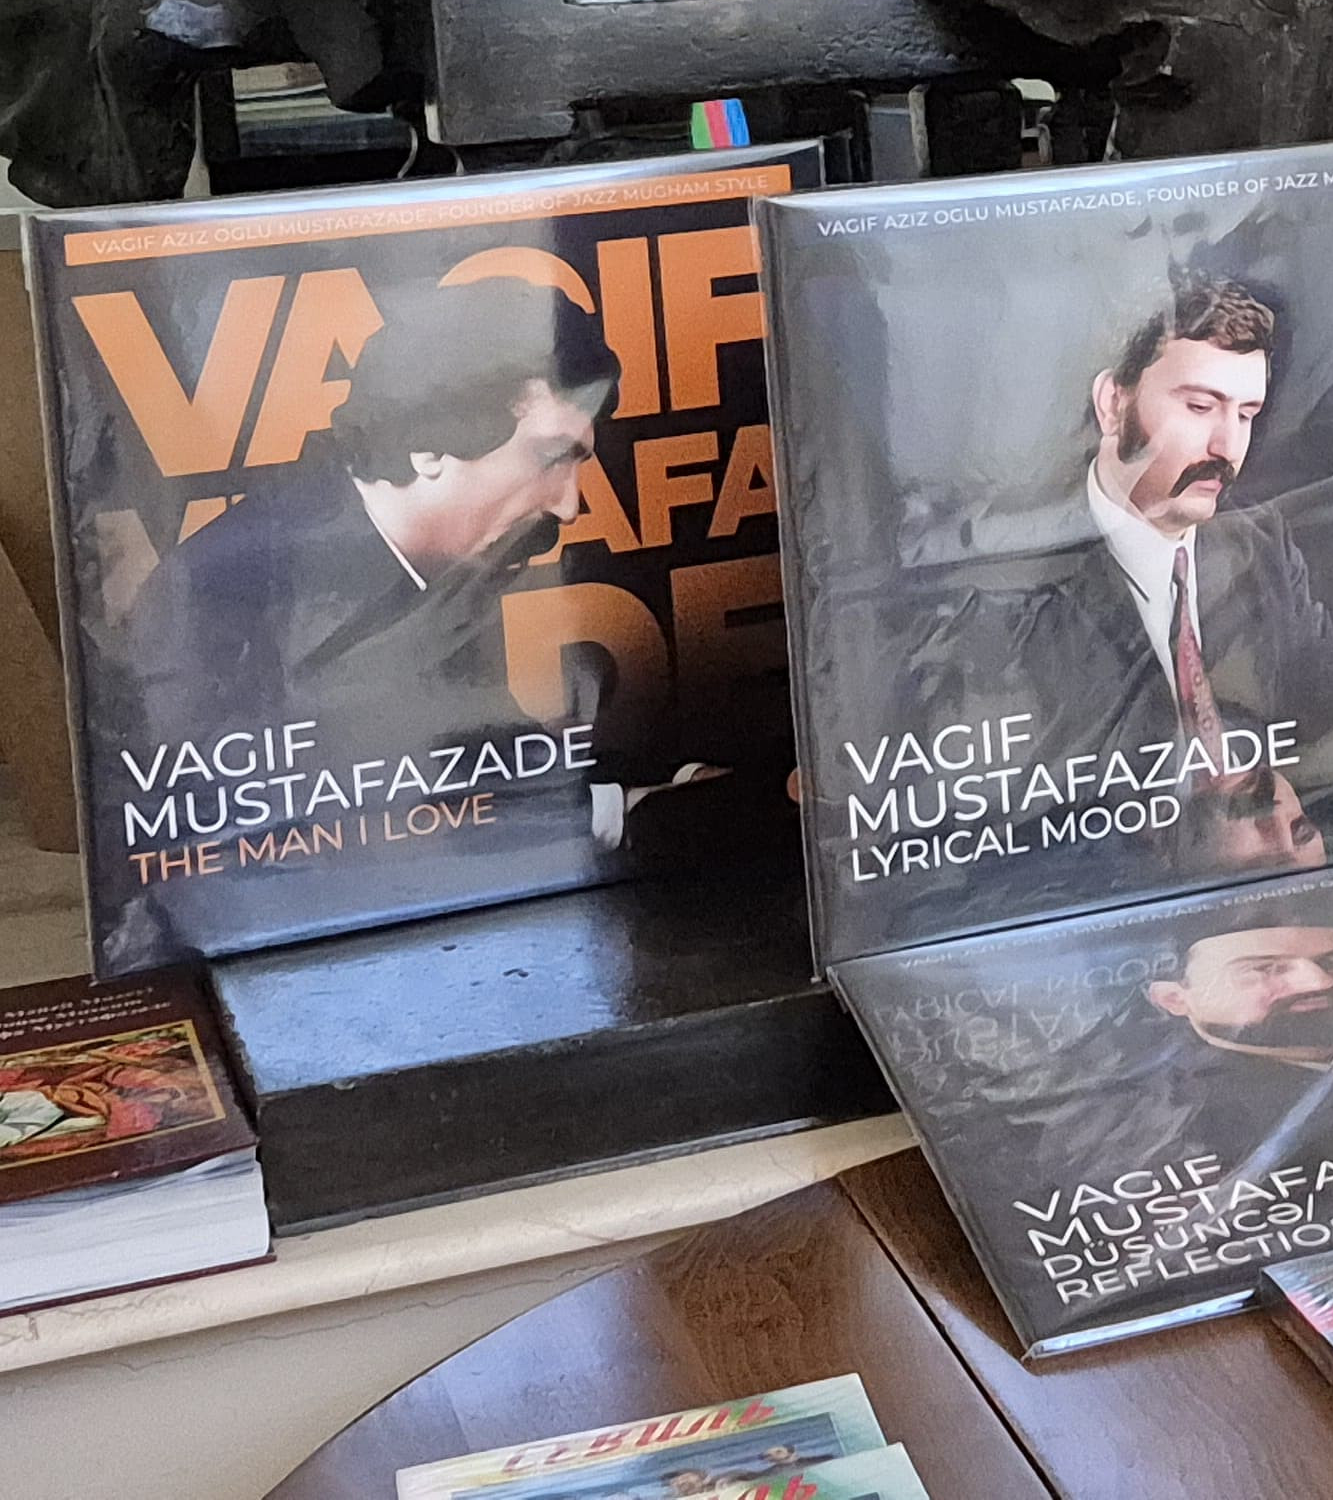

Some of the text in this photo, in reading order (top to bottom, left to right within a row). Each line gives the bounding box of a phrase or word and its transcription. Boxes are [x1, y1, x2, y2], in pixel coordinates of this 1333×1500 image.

[92, 232, 156, 257] VAGIF
[161, 228, 208, 249] AZIZ
[213, 221, 273, 243] OGLU
[437, 195, 535, 226] FOUNDER
[541, 193, 568, 212] OF
[622, 180, 712, 204] MUGHAM
[715, 173, 769, 195] STYLE
[818, 216, 879, 238] VAGIF
[884, 211, 929, 231] AZIZ
[933, 205, 989, 226] OGLU
[995, 189, 1143, 220] MUSTAFAZADE,
[1147, 180, 1240, 206] FOUNDER
[1245, 177, 1271, 195] OF
[1274, 171, 1319, 193] JAZZ
[71, 226, 768, 477] VAIF
[120, 720, 317, 792] VAGIF
[122, 724, 597, 847] MUSTAFAZADE
[844, 713, 1034, 785] VAGIF
[848, 720, 1301, 840] MUSTAFAZADE
[129, 792, 496, 885] THE MAN I LOVE
[852, 794, 1182, 882] LYRICAL MOOD
[1013, 1154, 1224, 1222] VAGIF
